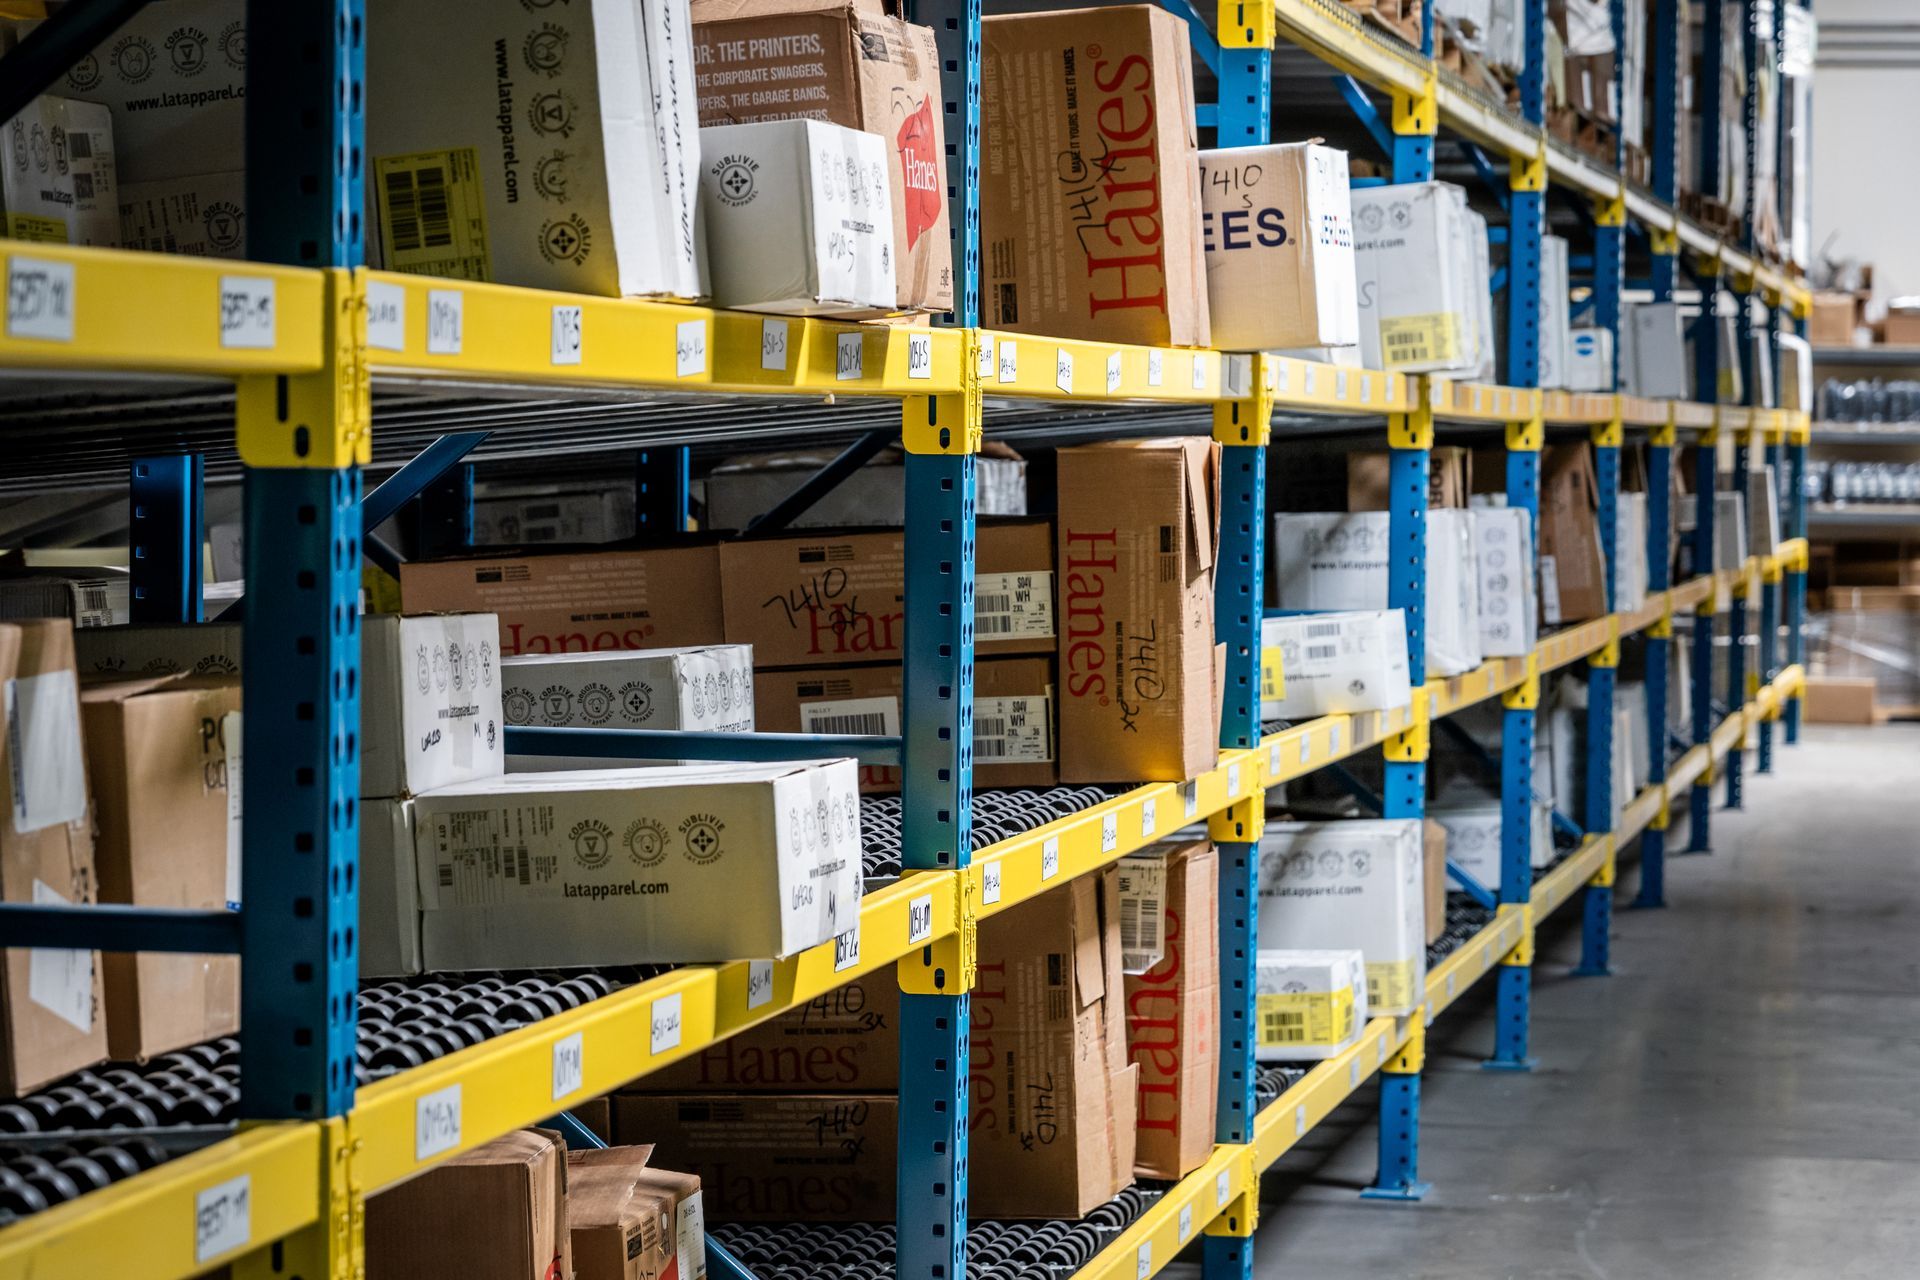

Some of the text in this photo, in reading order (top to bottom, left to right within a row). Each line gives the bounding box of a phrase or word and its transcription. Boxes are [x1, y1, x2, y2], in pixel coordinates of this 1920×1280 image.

[164, 27, 209, 50] CODE FIVE
[718, 41, 746, 62] THE
[749, 33, 825, 60] PRINTERS,
[712, 67, 769, 86] CORPORATE
[770, 62, 828, 81] SWAGGERS,
[731, 93, 751, 108] THE
[752, 89, 791, 105] GARAGE
[793, 85, 830, 102] BANDS,
[494, 38, 520, 204] www.latapparel.com
[711, 154, 761, 177] SUBLIVIE
[904, 147, 937, 192] Hanes
[1088, 54, 1166, 319] Hanes
[1241, 193, 1254, 209] S
[570, 213, 592, 267] SUBLIVIE
[762, 567, 848, 629] 7410
[1015, 590, 1031, 602] WH
[1067, 528, 1117, 698] Hanes
[1129, 619, 1165, 700] 7410
[539, 685, 574, 702] CODE FIVE
[577, 682, 616, 704] DOGGIE SKINS
[618, 681, 654, 696] SUBLIVIE
[1010, 714, 1025, 727] WH
[568, 819, 615, 841] CODE FIVE
[622, 817, 673, 847] DOGGIE SKINS
[678, 813, 726, 835] SUBLIVIE
[564, 880, 670, 901] latapparel.com
[698, 1038, 860, 1084] Hanes
[1026, 1072, 1057, 1144] 7410
[806, 1100, 869, 1147] 7410
